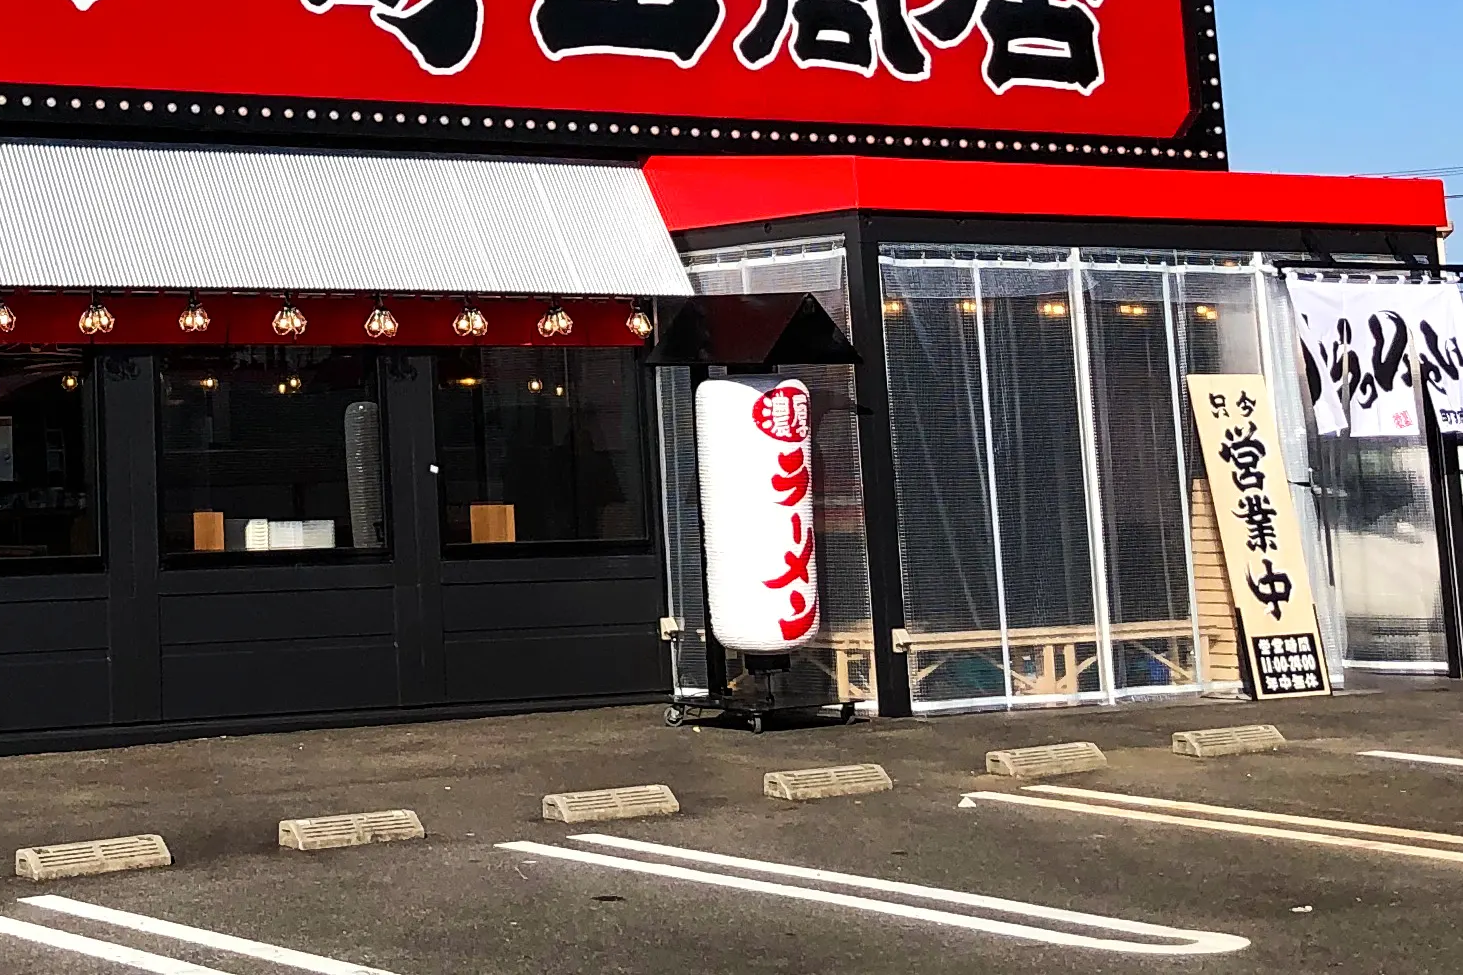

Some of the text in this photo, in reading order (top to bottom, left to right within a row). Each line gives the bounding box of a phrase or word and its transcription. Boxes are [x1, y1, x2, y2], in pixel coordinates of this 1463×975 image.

[1208, 390, 1257, 419] 只今
[761, 446, 818, 641] ラーメン
[1218, 420, 1292, 621] 営業中
